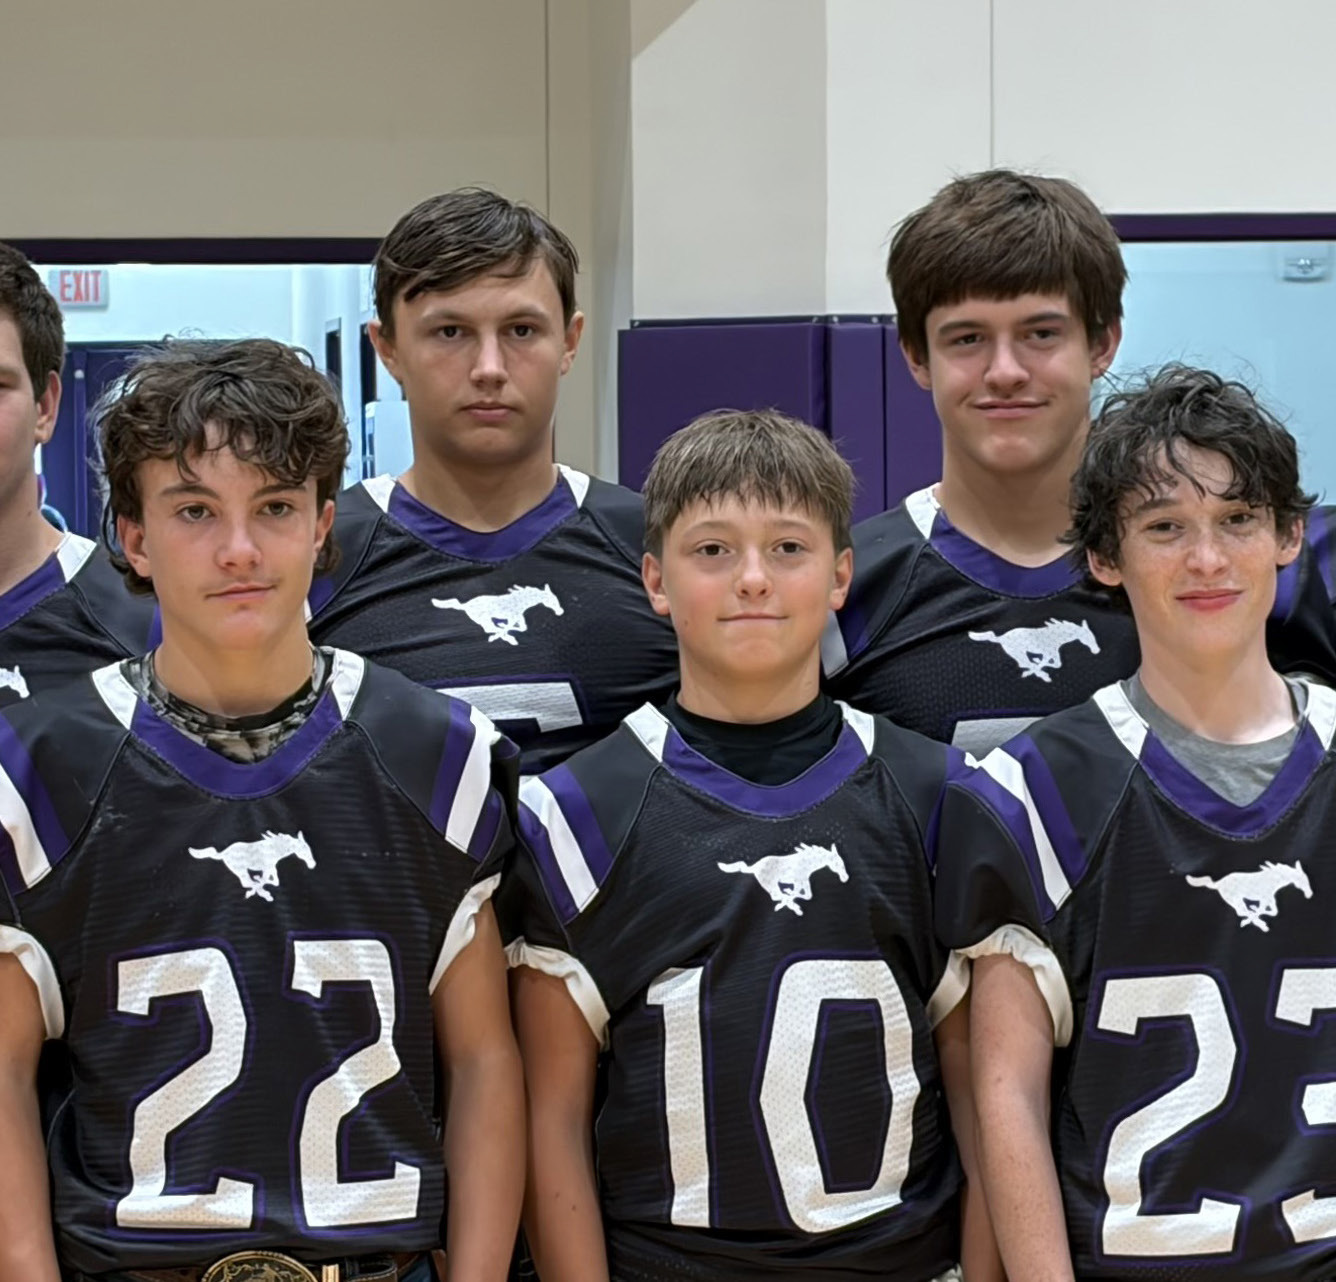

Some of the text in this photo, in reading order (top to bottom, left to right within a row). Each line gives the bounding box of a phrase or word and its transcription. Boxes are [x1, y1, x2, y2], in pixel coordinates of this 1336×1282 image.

[60, 270, 101, 302] EXIT
[116, 938, 421, 1229] 22
[646, 958, 921, 1233] 10
